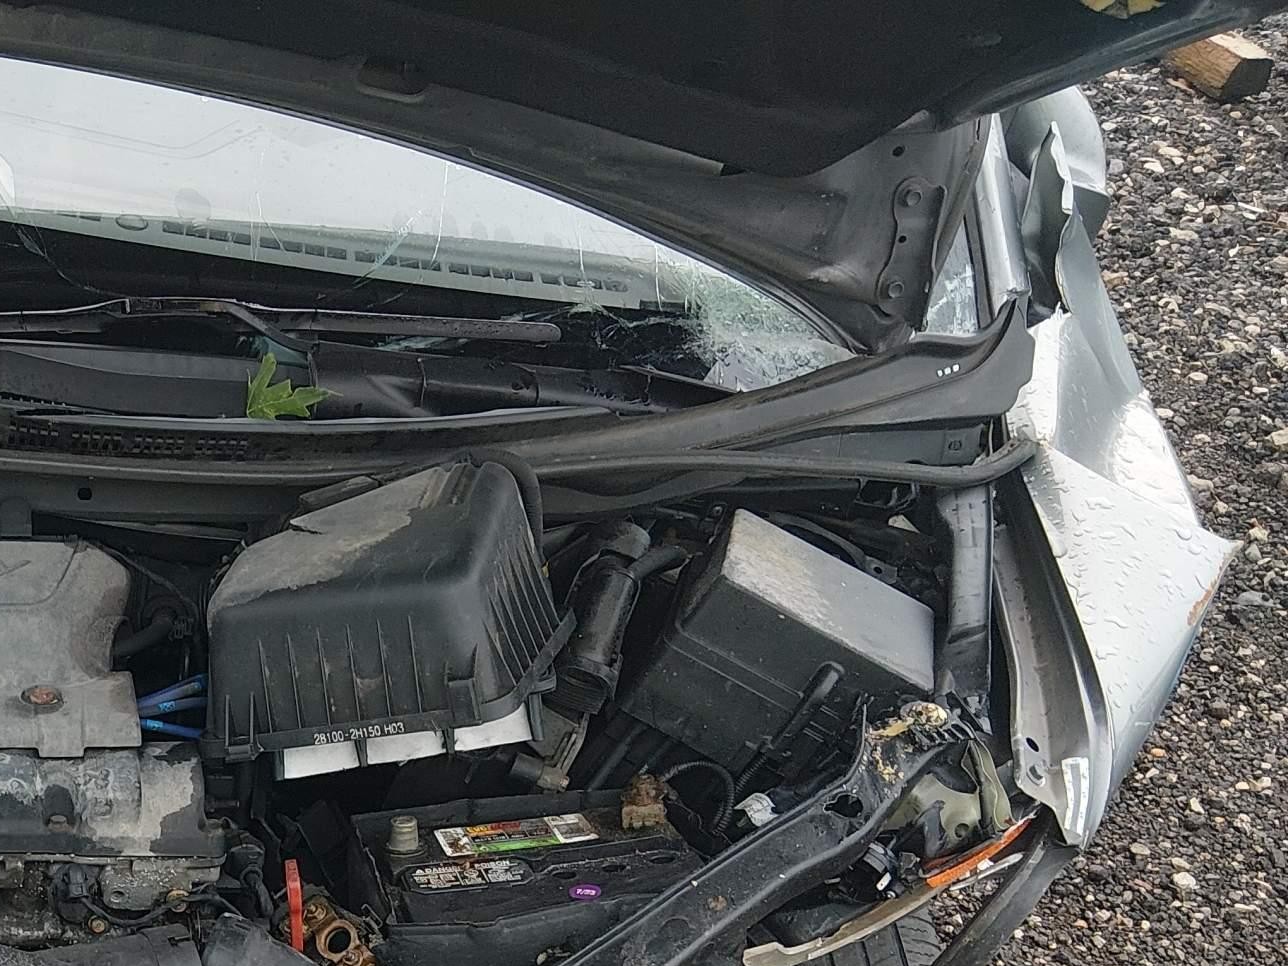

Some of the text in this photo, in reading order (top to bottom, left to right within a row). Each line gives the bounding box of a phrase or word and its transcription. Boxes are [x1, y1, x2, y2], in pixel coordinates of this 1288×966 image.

[314, 722, 405, 745] 28100-2H150 H03
[474, 860, 510, 871] POISON
